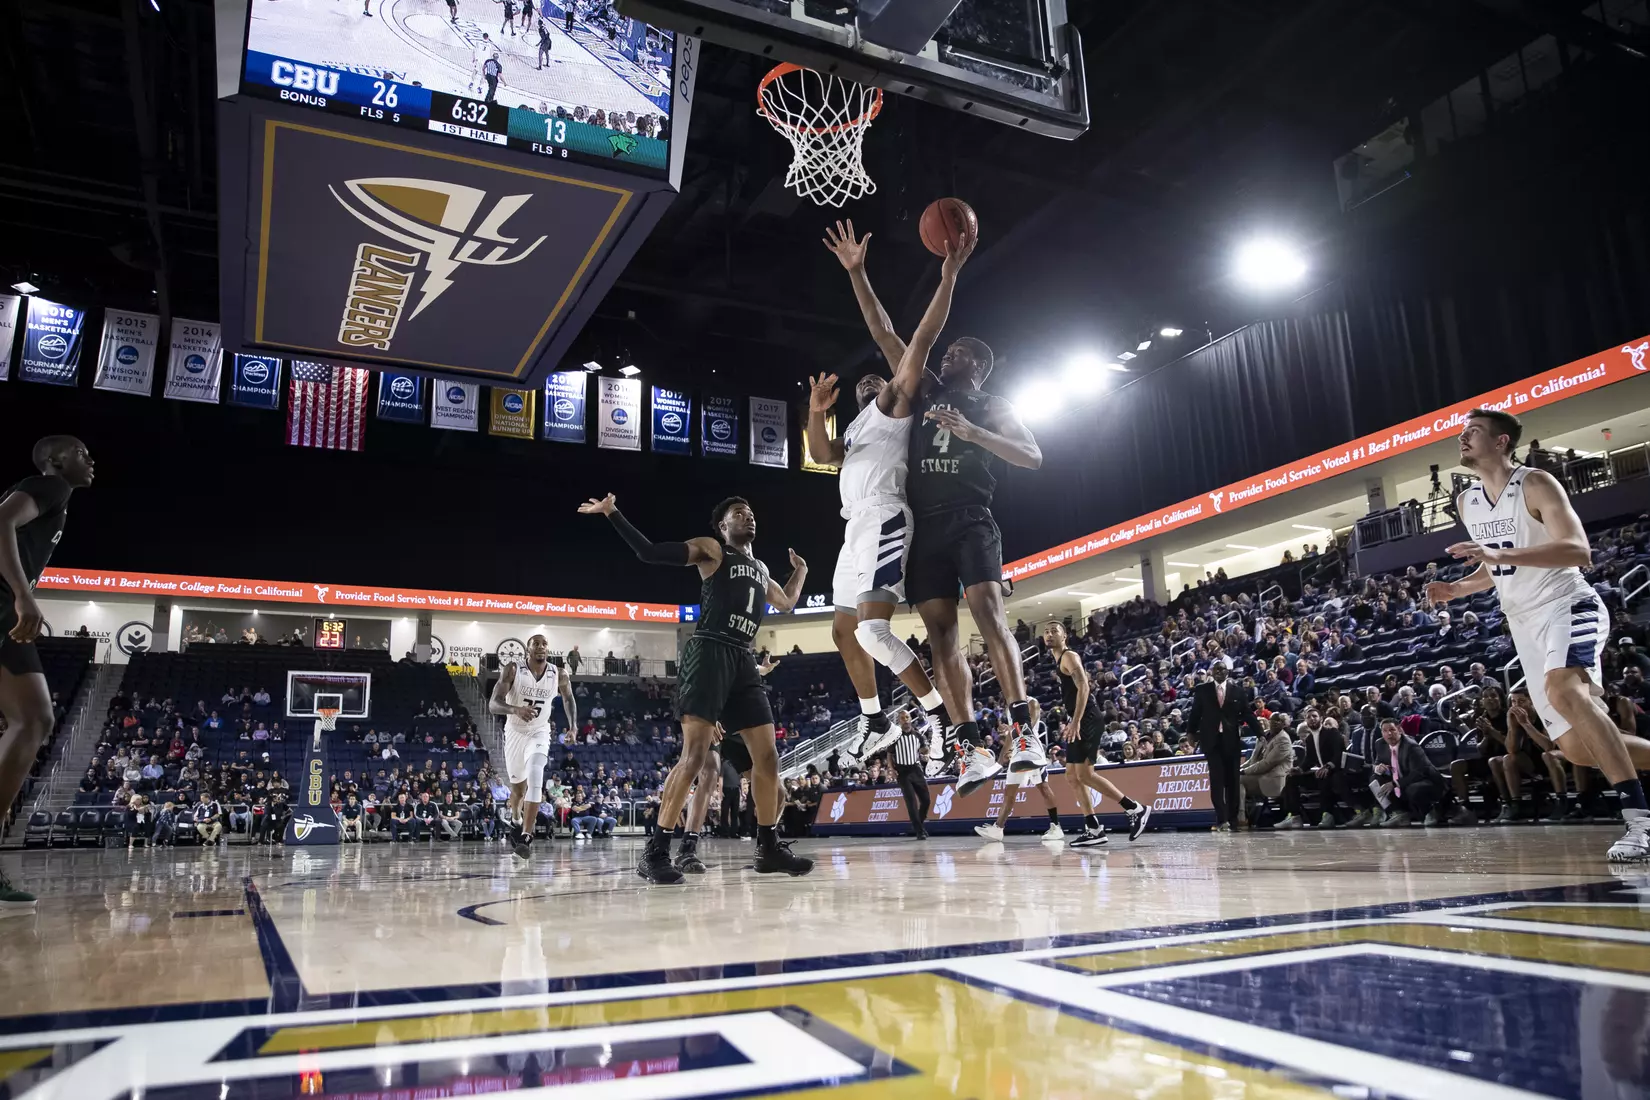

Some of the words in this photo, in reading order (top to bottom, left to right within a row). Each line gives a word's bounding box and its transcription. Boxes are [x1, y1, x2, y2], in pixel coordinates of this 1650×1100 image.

[270, 59, 341, 97] CBU
[280, 89, 327, 108] BONUS
[371, 81, 398, 108] 26
[360, 106, 384, 119] FLS
[392, 112, 400, 123] 5
[451, 99, 489, 126] 6:32
[442, 122, 463, 135] 1ST
[470, 128, 499, 143] HALF
[544, 117, 567, 144] 13
[532, 142, 553, 155] FLS
[561, 148, 569, 158] 8
[338, 243, 421, 351] LANCERS
[40, 316, 69, 327] MEN'S
[116, 316, 148, 329] 2015
[117, 327, 143, 337] MEN'S
[182, 326, 213, 338] 2014
[104, 333, 154, 346] BASKETBALL
[183, 337, 209, 346] MEN'S
[102, 365, 140, 376] DIVISION
[104, 373, 133, 384] SWEET
[134, 377, 143, 385] 16
[175, 375, 206, 385] DIVISION
[231, 384, 277, 396] CHAMPIONS
[660, 388, 684, 400] 2017
[380, 399, 423, 410] CHAMPIONS
[656, 397, 686, 407] WOMEN'S
[709, 396, 732, 406] 2017
[452, 407, 476, 415] REGION
[757, 403, 779, 413] 2017
[436, 411, 474, 421] CHAMPIONS
[494, 414, 524, 423] DIVISION
[492, 425, 521, 433] RUNNER
[495, 420, 529, 429] NATIONAL
[544, 421, 584, 431] CHAMPIONS
[605, 426, 628, 434] DIVISION
[600, 431, 639, 441] TOURNAMENT
[653, 434, 690, 443] CHAMPIONS
[1228, 480, 1264, 503] Provider
[1265, 472, 1288, 492] Food
[1288, 463, 1322, 484] Service
[1321, 451, 1351, 471] Voted
[1352, 446, 1366, 461] #1
[1368, 438, 1391, 456] Best
[1392, 424, 1432, 448] Private
[1514, 391, 1529, 406] in
[1530, 363, 1607, 400] California!
[932, 428, 951, 453] 4
[921, 458, 960, 475] STATE
[1470, 517, 1517, 541] LANCERS
[1013, 562, 1028, 577] Food
[1028, 557, 1048, 573] Service
[1047, 550, 1065, 565] Voted
[1065, 548, 1073, 559] #1
[1073, 543, 1087, 557] Best
[1087, 537, 1110, 552] Private
[1110, 529, 1135, 544] College
[1135, 520, 1154, 535] Food
[1154, 518, 1162, 529] in
[1162, 503, 1202, 526] California!
[39, 574, 70, 585] ervice
[72, 574, 101, 586] Voted
[103, 577, 117, 588] #1
[119, 577, 142, 589] Best
[142, 579, 178, 591] Private
[179, 581, 215, 594] College
[216, 583, 241, 594] Food
[243, 585, 253, 595] in
[254, 585, 304, 598] California!
[335, 590, 372, 602] Provider
[373, 592, 395, 602] Food
[397, 594, 427, 605] Service
[427, 595, 452, 606] Voted
[453, 597, 464, 607] #1
[466, 598, 485, 608] Best
[484, 599, 514, 610] Private
[515, 600, 545, 612] College
[545, 602, 566, 613] Food
[567, 603, 576, 613] in
[576, 604, 618, 616] California!
[745, 586, 756, 615] 1
[806, 594, 826, 607] 6:32
[643, 608, 674, 619] Provider
[322, 621, 344, 632] 6:32
[728, 613, 758, 638] STATE
[319, 631, 340, 647] 23
[308, 759, 323, 806] CBU
[1156, 778, 1211, 795] MEDICAL
[871, 799, 899, 811] MEDICAL
[1153, 796, 1193, 811] CLINIC
[868, 812, 889, 822] CLINIC
